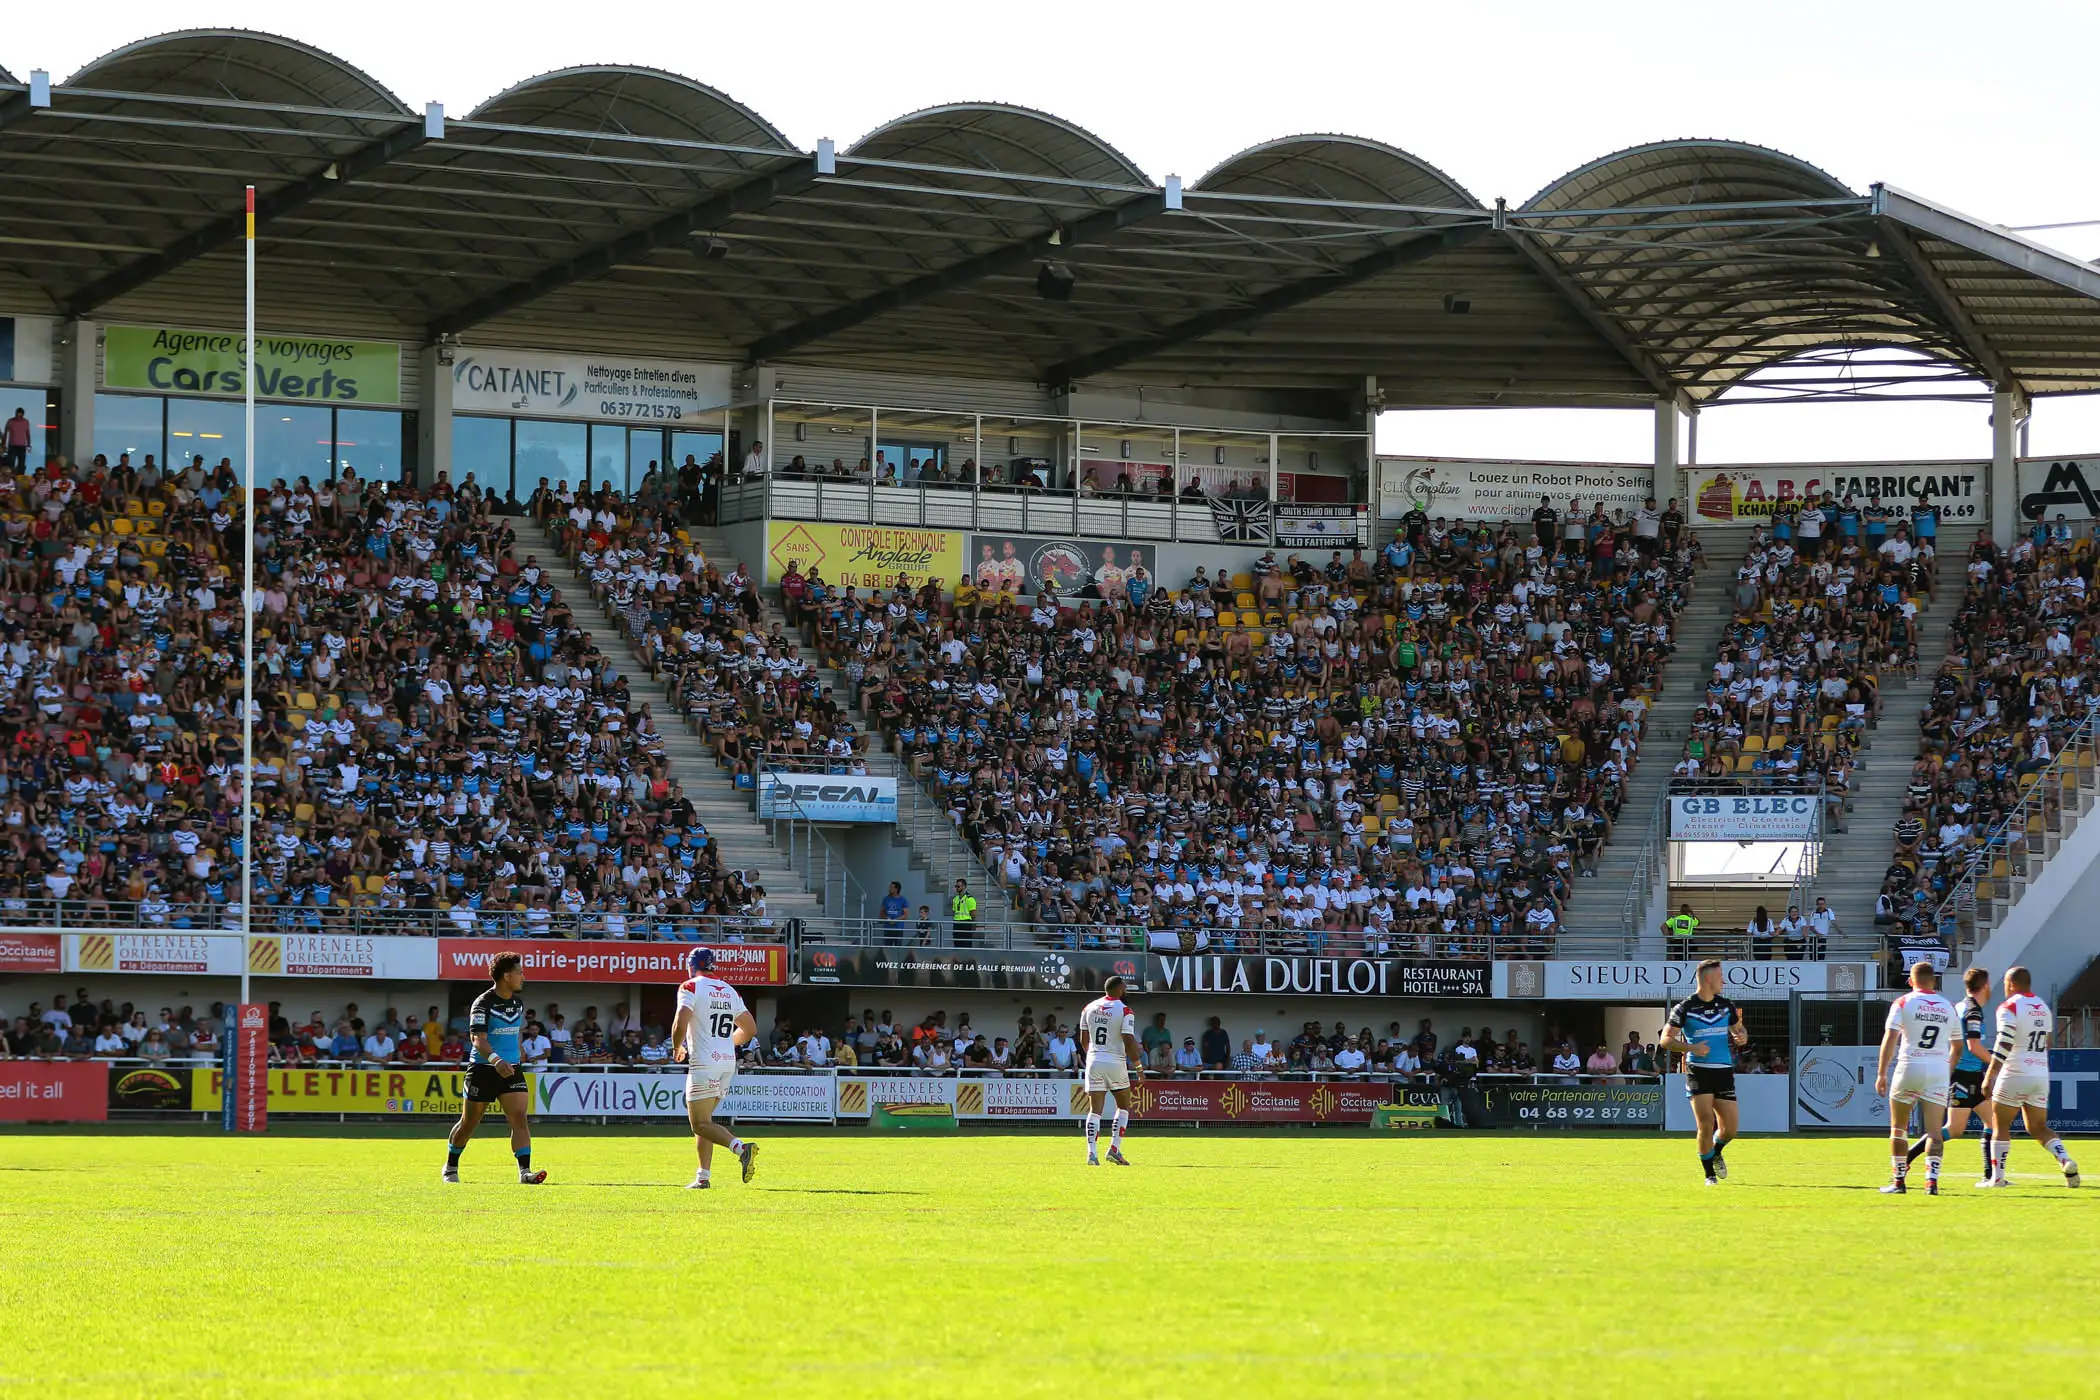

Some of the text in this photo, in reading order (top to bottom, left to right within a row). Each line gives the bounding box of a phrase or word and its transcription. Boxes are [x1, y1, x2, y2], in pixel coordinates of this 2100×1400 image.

[153, 330, 231, 355] Agence
[268, 340, 354, 365] voyages
[149, 357, 358, 399] Cars Verts
[468, 366, 566, 397] CATANET
[587, 364, 696, 384] Nettoyage Entretien divers
[584, 381, 698, 401] Particuliers & Professionnels
[600, 401, 681, 419] 06 37 72 15 78
[1469, 471, 1653, 489] Louez un Robot Photo Selfie
[1834, 476, 1975, 498] FABRICANT
[1474, 487, 1648, 502] pour animer vos événements
[1280, 507, 1301, 516] SOUTH
[1303, 507, 1322, 516] STAND
[786, 543, 810, 552] SANS
[841, 528, 946, 553] CONTROLE TECHNIQUE
[849, 542, 932, 568] Anglade
[889, 563, 930, 571] GROUPE
[841, 572, 858, 587] 04
[863, 573, 880, 587] 68
[1682, 798, 1808, 814] GB ELEC
[0, 945, 56, 957] Occitanie
[120, 949, 208, 960] ORIENTALES
[287, 952, 373, 964] ORIENTALES
[140, 963, 197, 972] Département
[307, 967, 362, 975] Département
[876, 961, 898, 969] VIVEZ
[900, 961, 951, 971] L'EXPÉRIENCE
[977, 964, 998, 972] SALLE
[1001, 965, 1036, 973] PREMIUM
[1040, 966, 1056, 974] ICE
[1403, 967, 1483, 981] RESTAURANT
[1158, 956, 1391, 994] VILLA DUFLOT
[1571, 965, 1659, 985] SIEUR
[709, 991, 730, 999] ALTRAD
[1403, 981, 1484, 995] HOTEL SPA
[709, 1000, 732, 1010] JULLIEN
[709, 1013, 734, 1038] 16
[1095, 1027, 1107, 1045] 6
[1918, 1026, 1939, 1049] 9
[2027, 1031, 2046, 1052] 10
[26, 1081, 38, 1098] it
[44, 1082, 63, 1099] all
[211, 1071, 405, 1098] PLETIER
[574, 1076, 688, 1111] VillaVer
[871, 1094, 943, 1104] ORIENTALES
[988, 1095, 1058, 1105] ORIENTALES
[1160, 1096, 1208, 1105] Occitanie
[1251, 1096, 1300, 1106] Occitanie
[1509, 1089, 1659, 1104] votre Partenaire Voyage
[722, 1100, 828, 1112] ANIMALERIE-FLEURISTERIE
[1341, 1097, 1388, 1107] Occitanie
[1004, 1107, 1049, 1115] Département
[1519, 1107, 1648, 1119] 04 68 92 87 88
